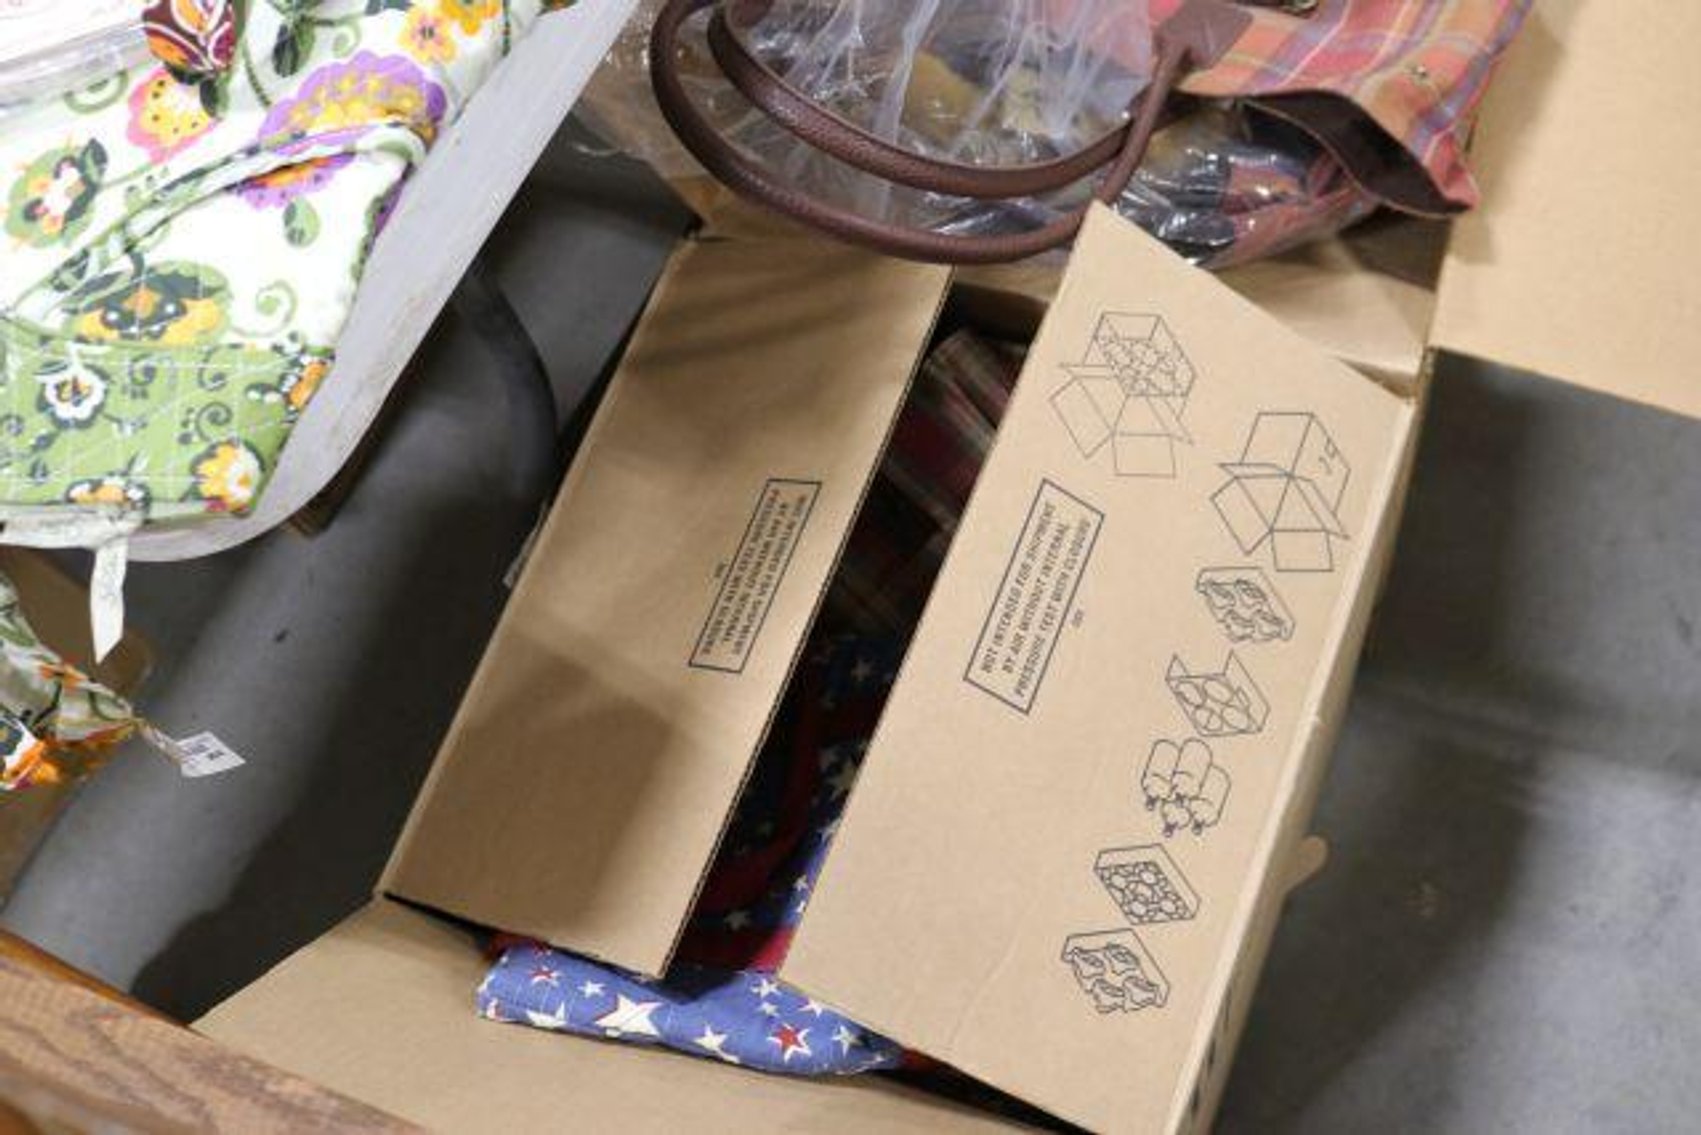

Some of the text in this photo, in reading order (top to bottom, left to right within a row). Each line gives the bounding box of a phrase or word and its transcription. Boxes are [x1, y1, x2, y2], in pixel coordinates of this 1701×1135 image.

[1001, 521, 1069, 675] BY AIR WITHOUT INTERNAL
[979, 646, 998, 674] NOT
